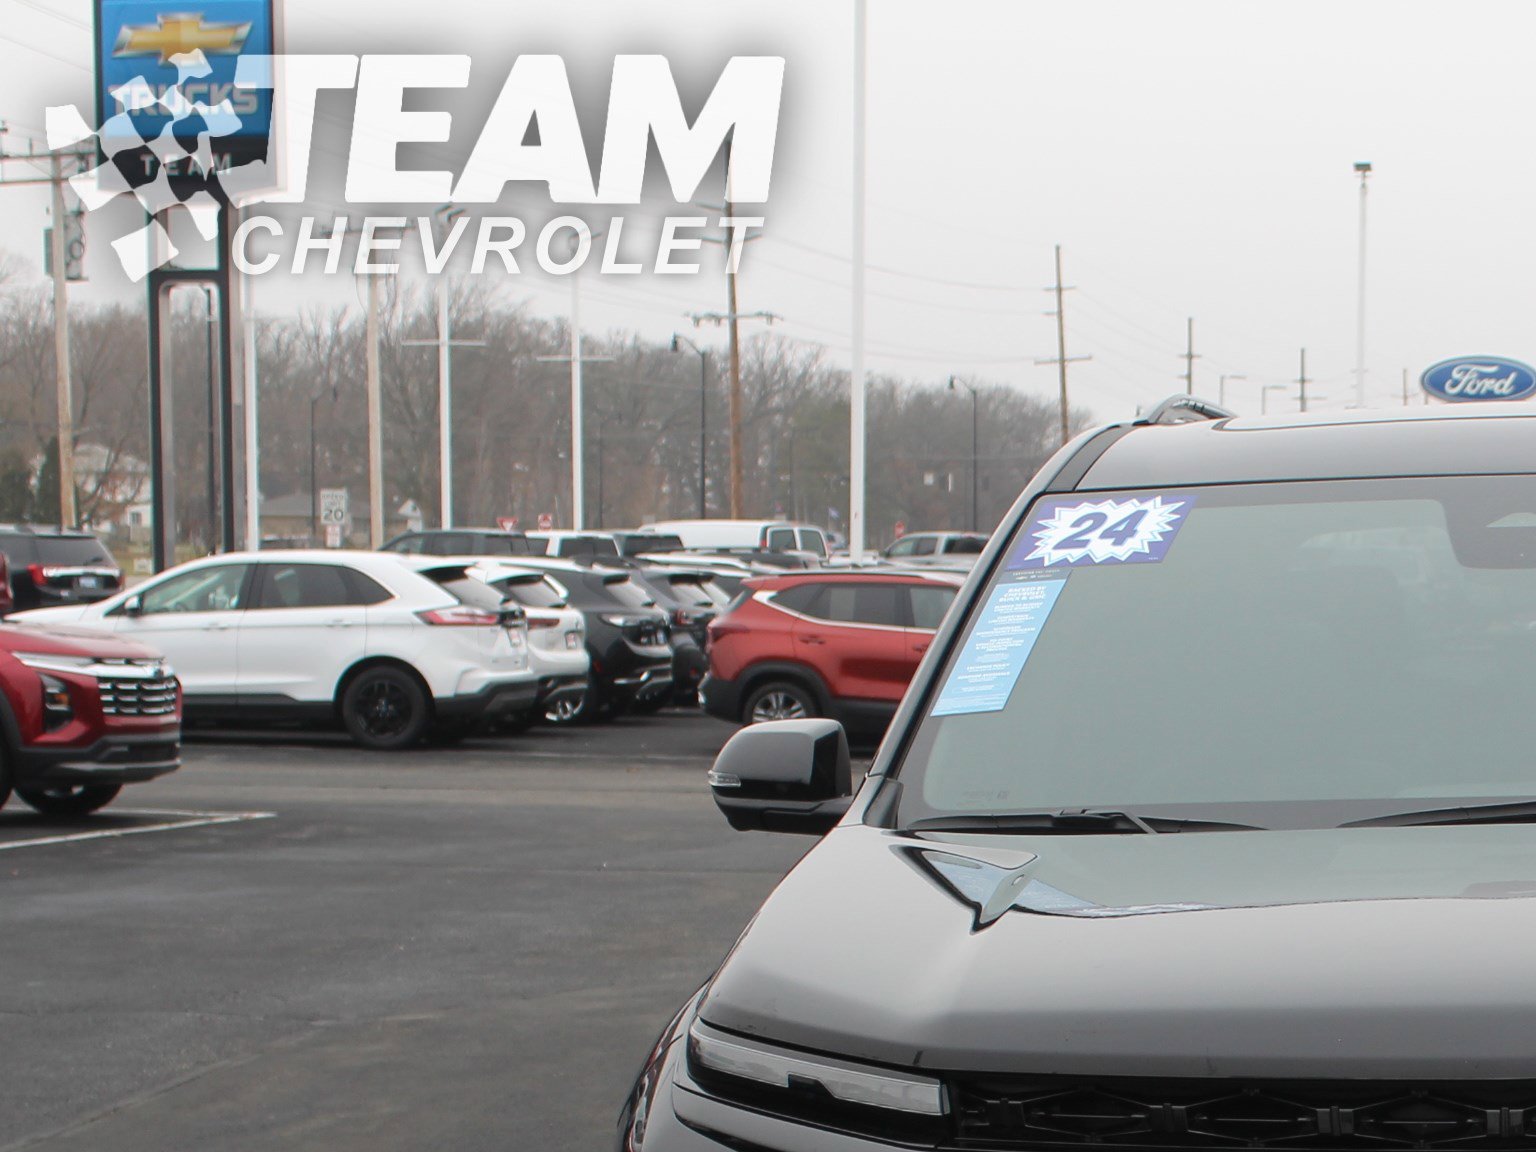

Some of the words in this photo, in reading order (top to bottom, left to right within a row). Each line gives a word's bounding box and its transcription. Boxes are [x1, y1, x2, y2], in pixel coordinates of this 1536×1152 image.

[108, 82, 258, 117] TRUCKS
[1444, 363, 1518, 396] Ford
[1052, 509, 1149, 550] 24
